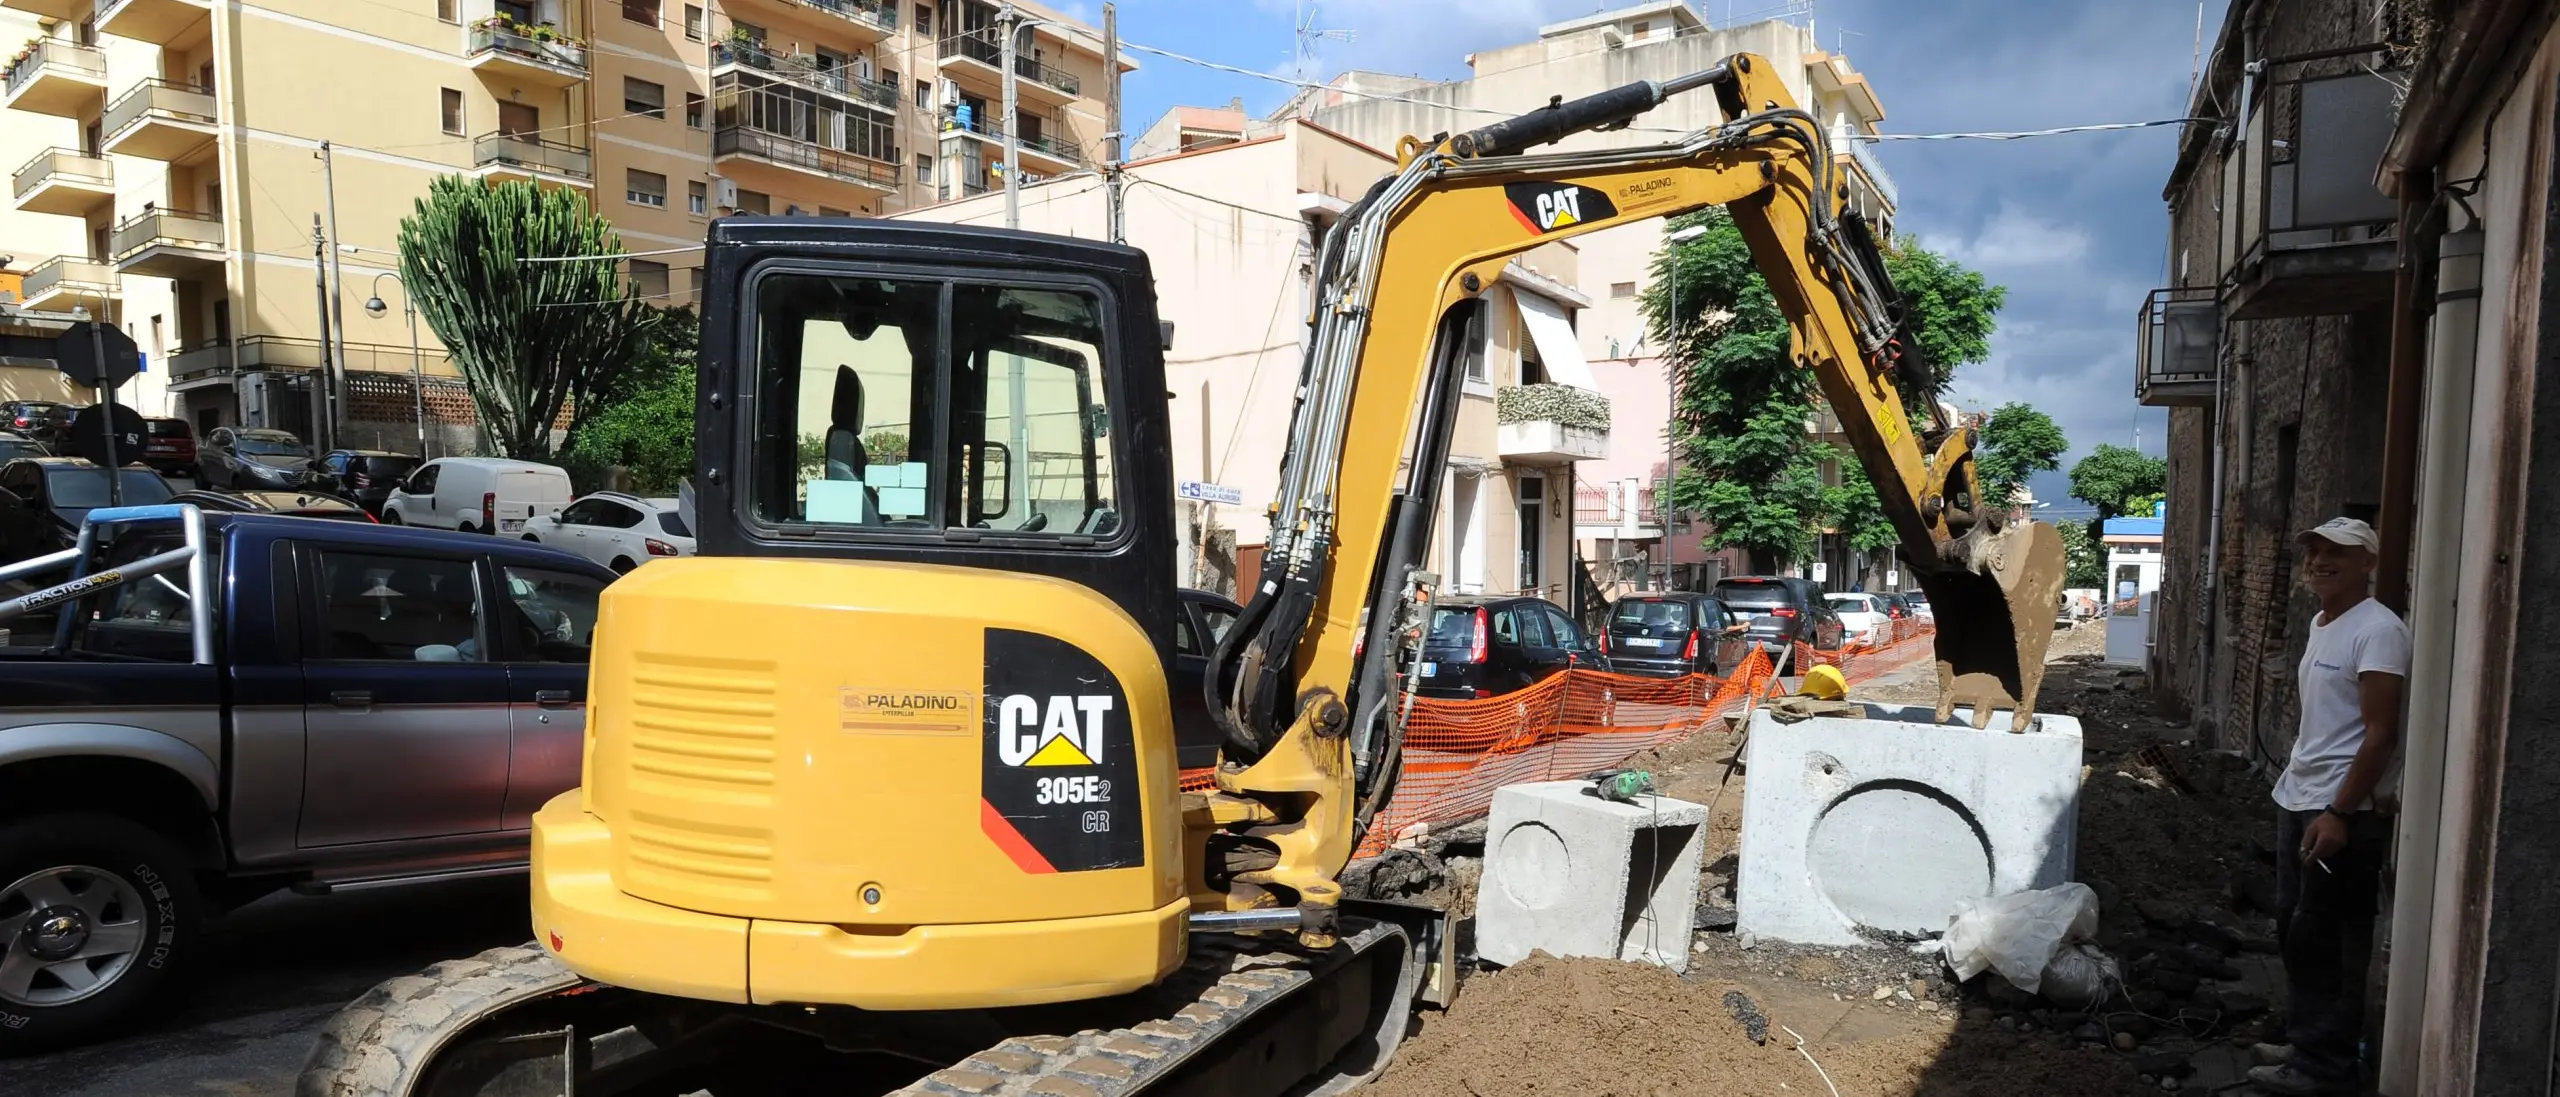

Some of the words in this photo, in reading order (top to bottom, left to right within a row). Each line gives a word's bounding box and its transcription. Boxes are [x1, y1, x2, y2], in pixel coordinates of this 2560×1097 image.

[1629, 176, 1672, 194] PALADINO
[1536, 186, 1582, 230] CAT
[867, 695, 958, 710] PALADINO
[999, 694, 1113, 767] CAT
[1036, 776, 1111, 805] 305E2
[1082, 810, 1110, 833] CR
[134, 864, 175, 969] NEXEN
